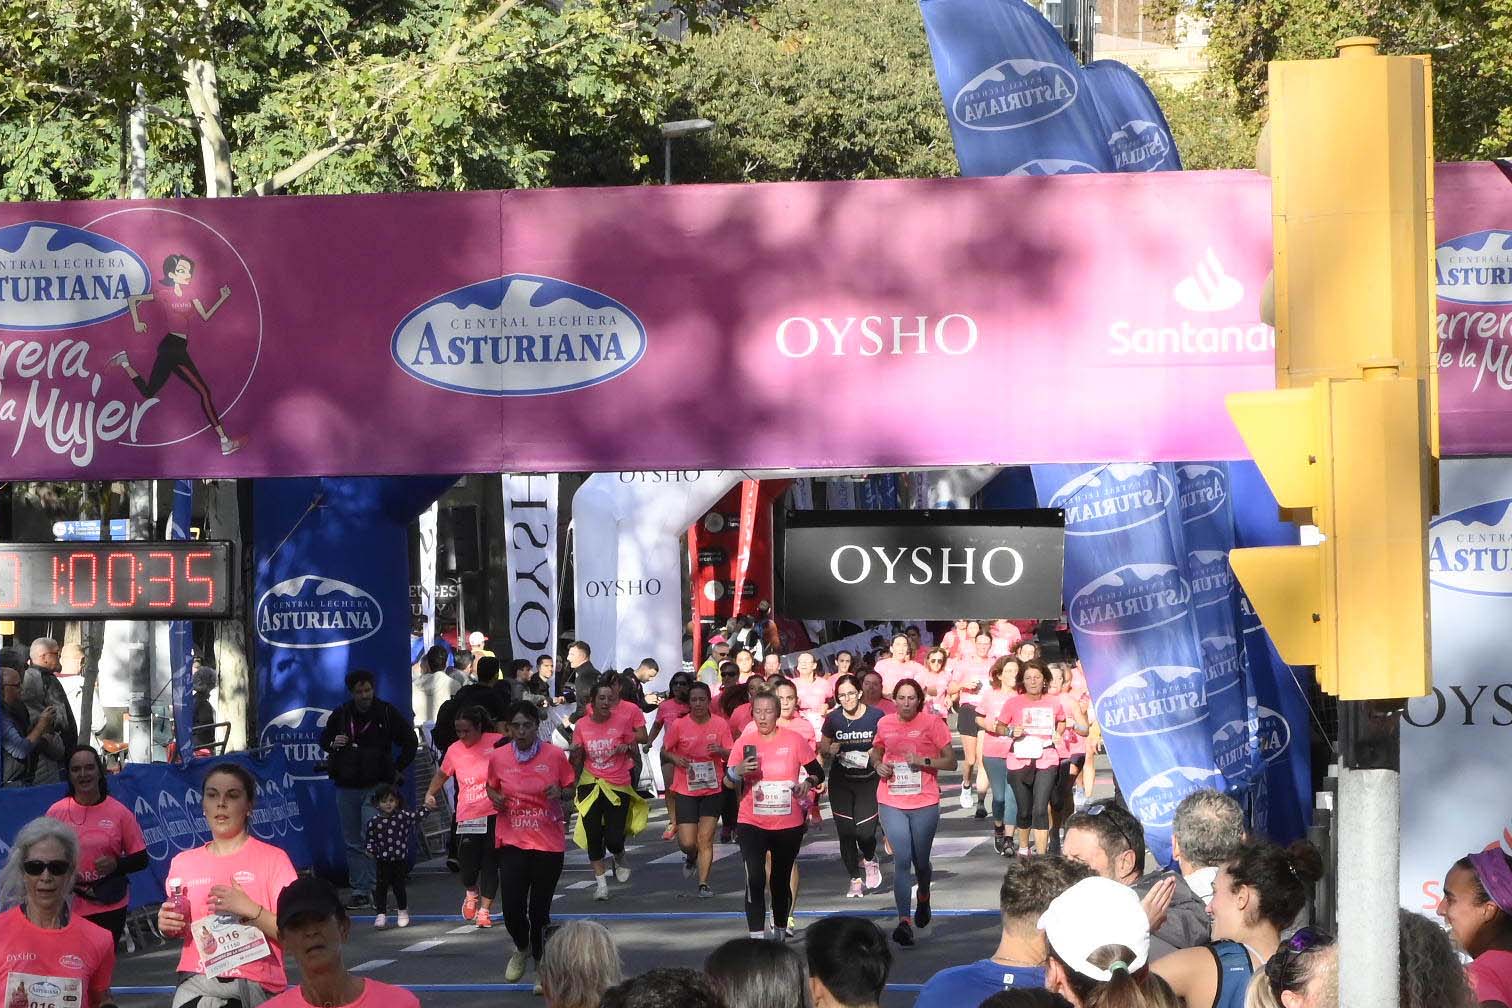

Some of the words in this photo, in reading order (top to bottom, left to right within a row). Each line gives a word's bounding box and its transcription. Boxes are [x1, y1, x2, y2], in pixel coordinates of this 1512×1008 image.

[54, 258, 125, 269] LECHERA
[450, 317, 525, 330] CENTRAL
[537, 314, 618, 328] LECHERA
[776, 313, 978, 358] OYSHO
[411, 321, 626, 365] ASTURIANA
[1458, 340, 1477, 368] la
[12, 374, 161, 467] Mujer
[829, 545, 1024, 586] OYSHO
[586, 578, 661, 598] OYSHO
[261, 605, 373, 632] ASTURIANA
[835, 730, 873, 740] Gartner
[218, 930, 240, 945] 016
